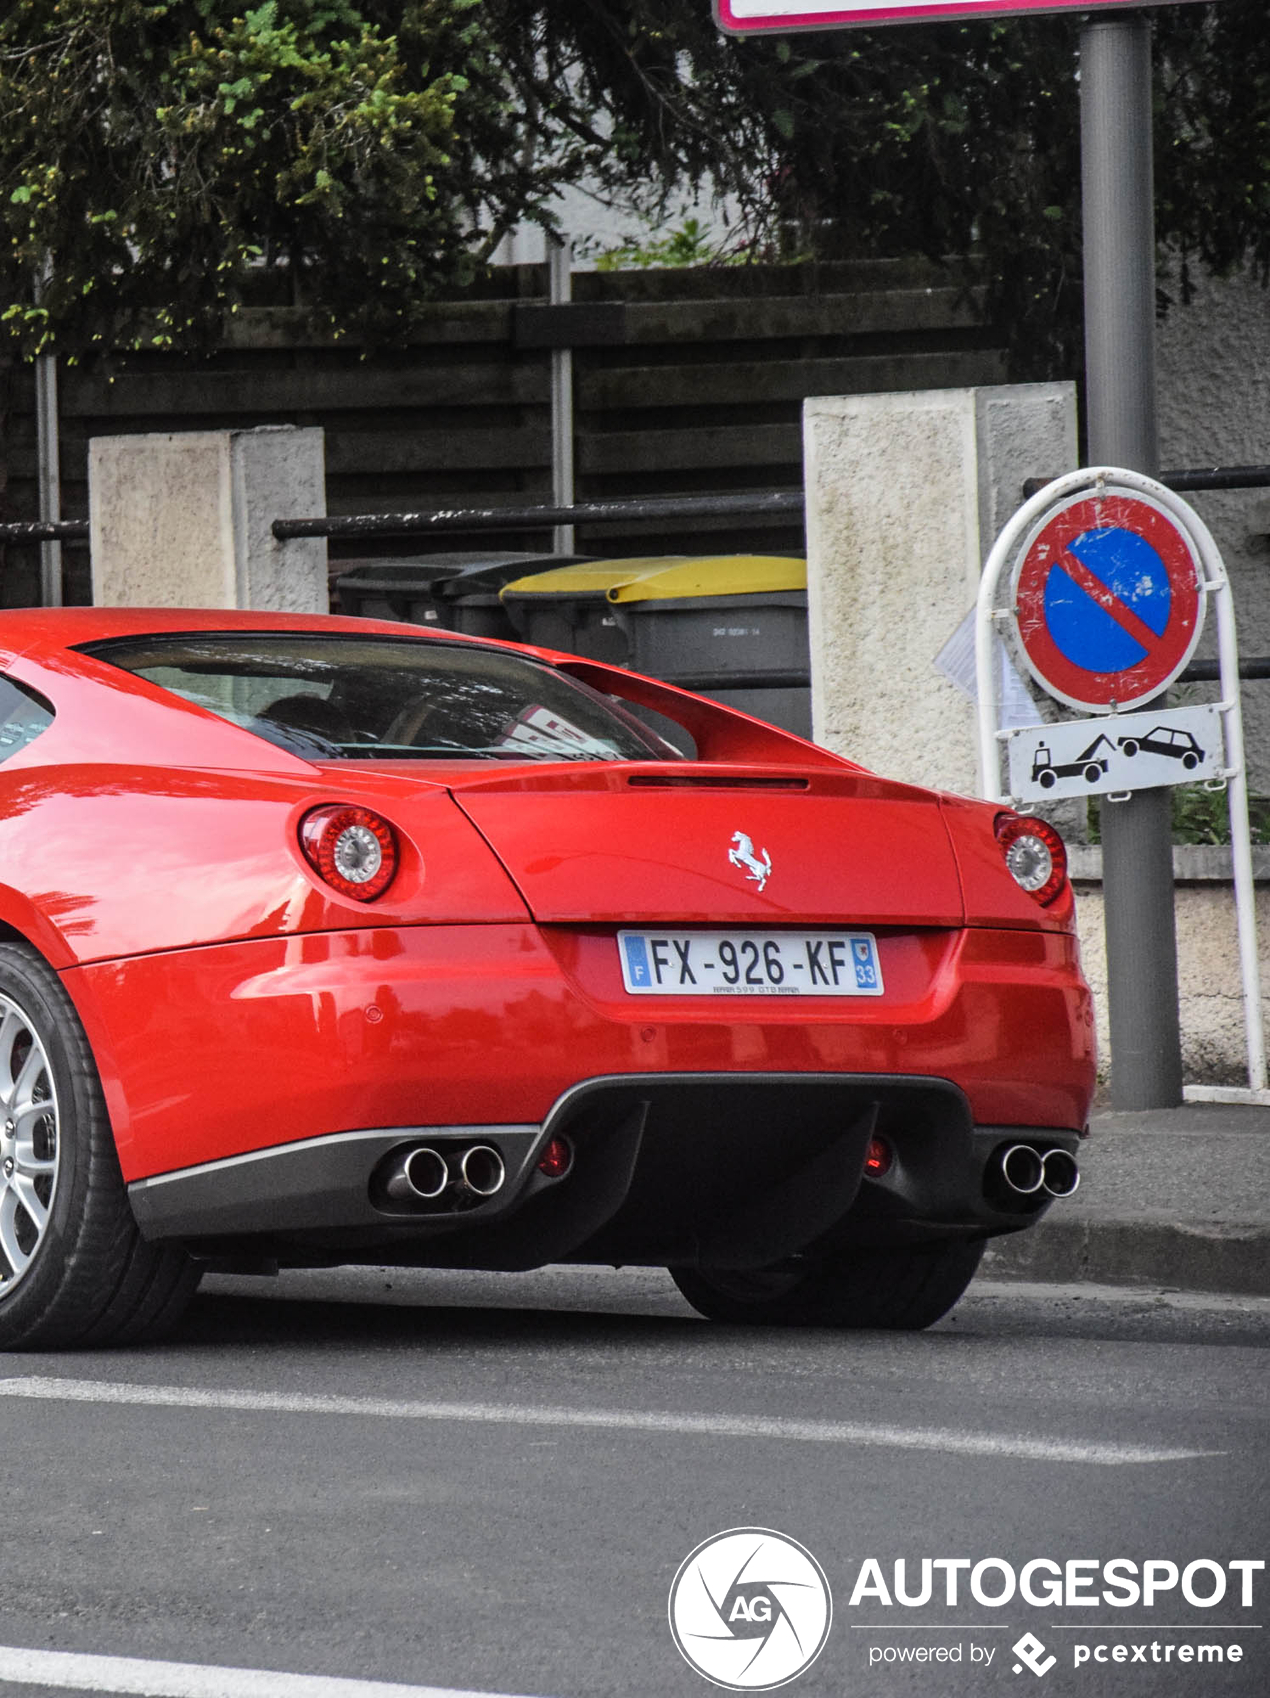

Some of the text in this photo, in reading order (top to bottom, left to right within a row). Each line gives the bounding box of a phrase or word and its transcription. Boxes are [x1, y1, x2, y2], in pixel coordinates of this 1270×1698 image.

[650, 940, 846, 985] FX-926-KF
[634, 966, 644, 981] F
[856, 965, 875, 984] 33
